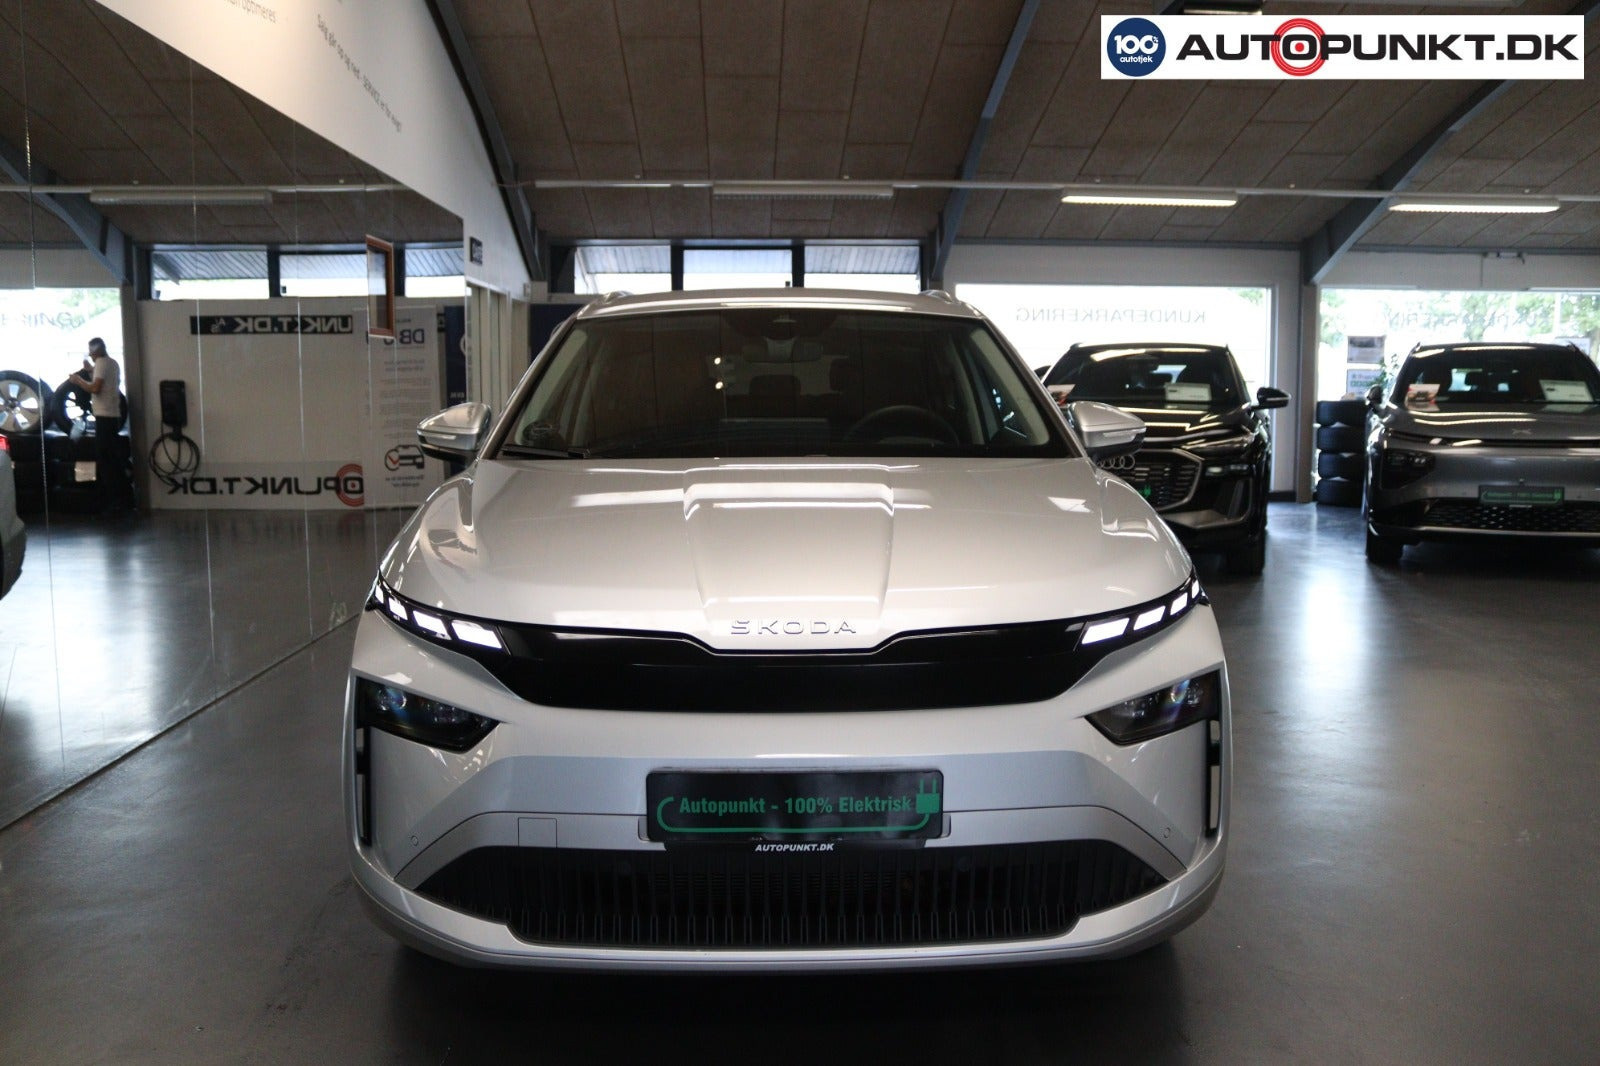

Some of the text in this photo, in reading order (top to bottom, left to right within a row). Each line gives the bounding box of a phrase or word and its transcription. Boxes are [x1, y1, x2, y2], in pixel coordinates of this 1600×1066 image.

[679, 797, 766, 816] Autopunkt
[785, 797, 833, 814] 100%
[839, 796, 912, 813] Elektrisk
[755, 843, 835, 852] AUTOPUNKT.DK
